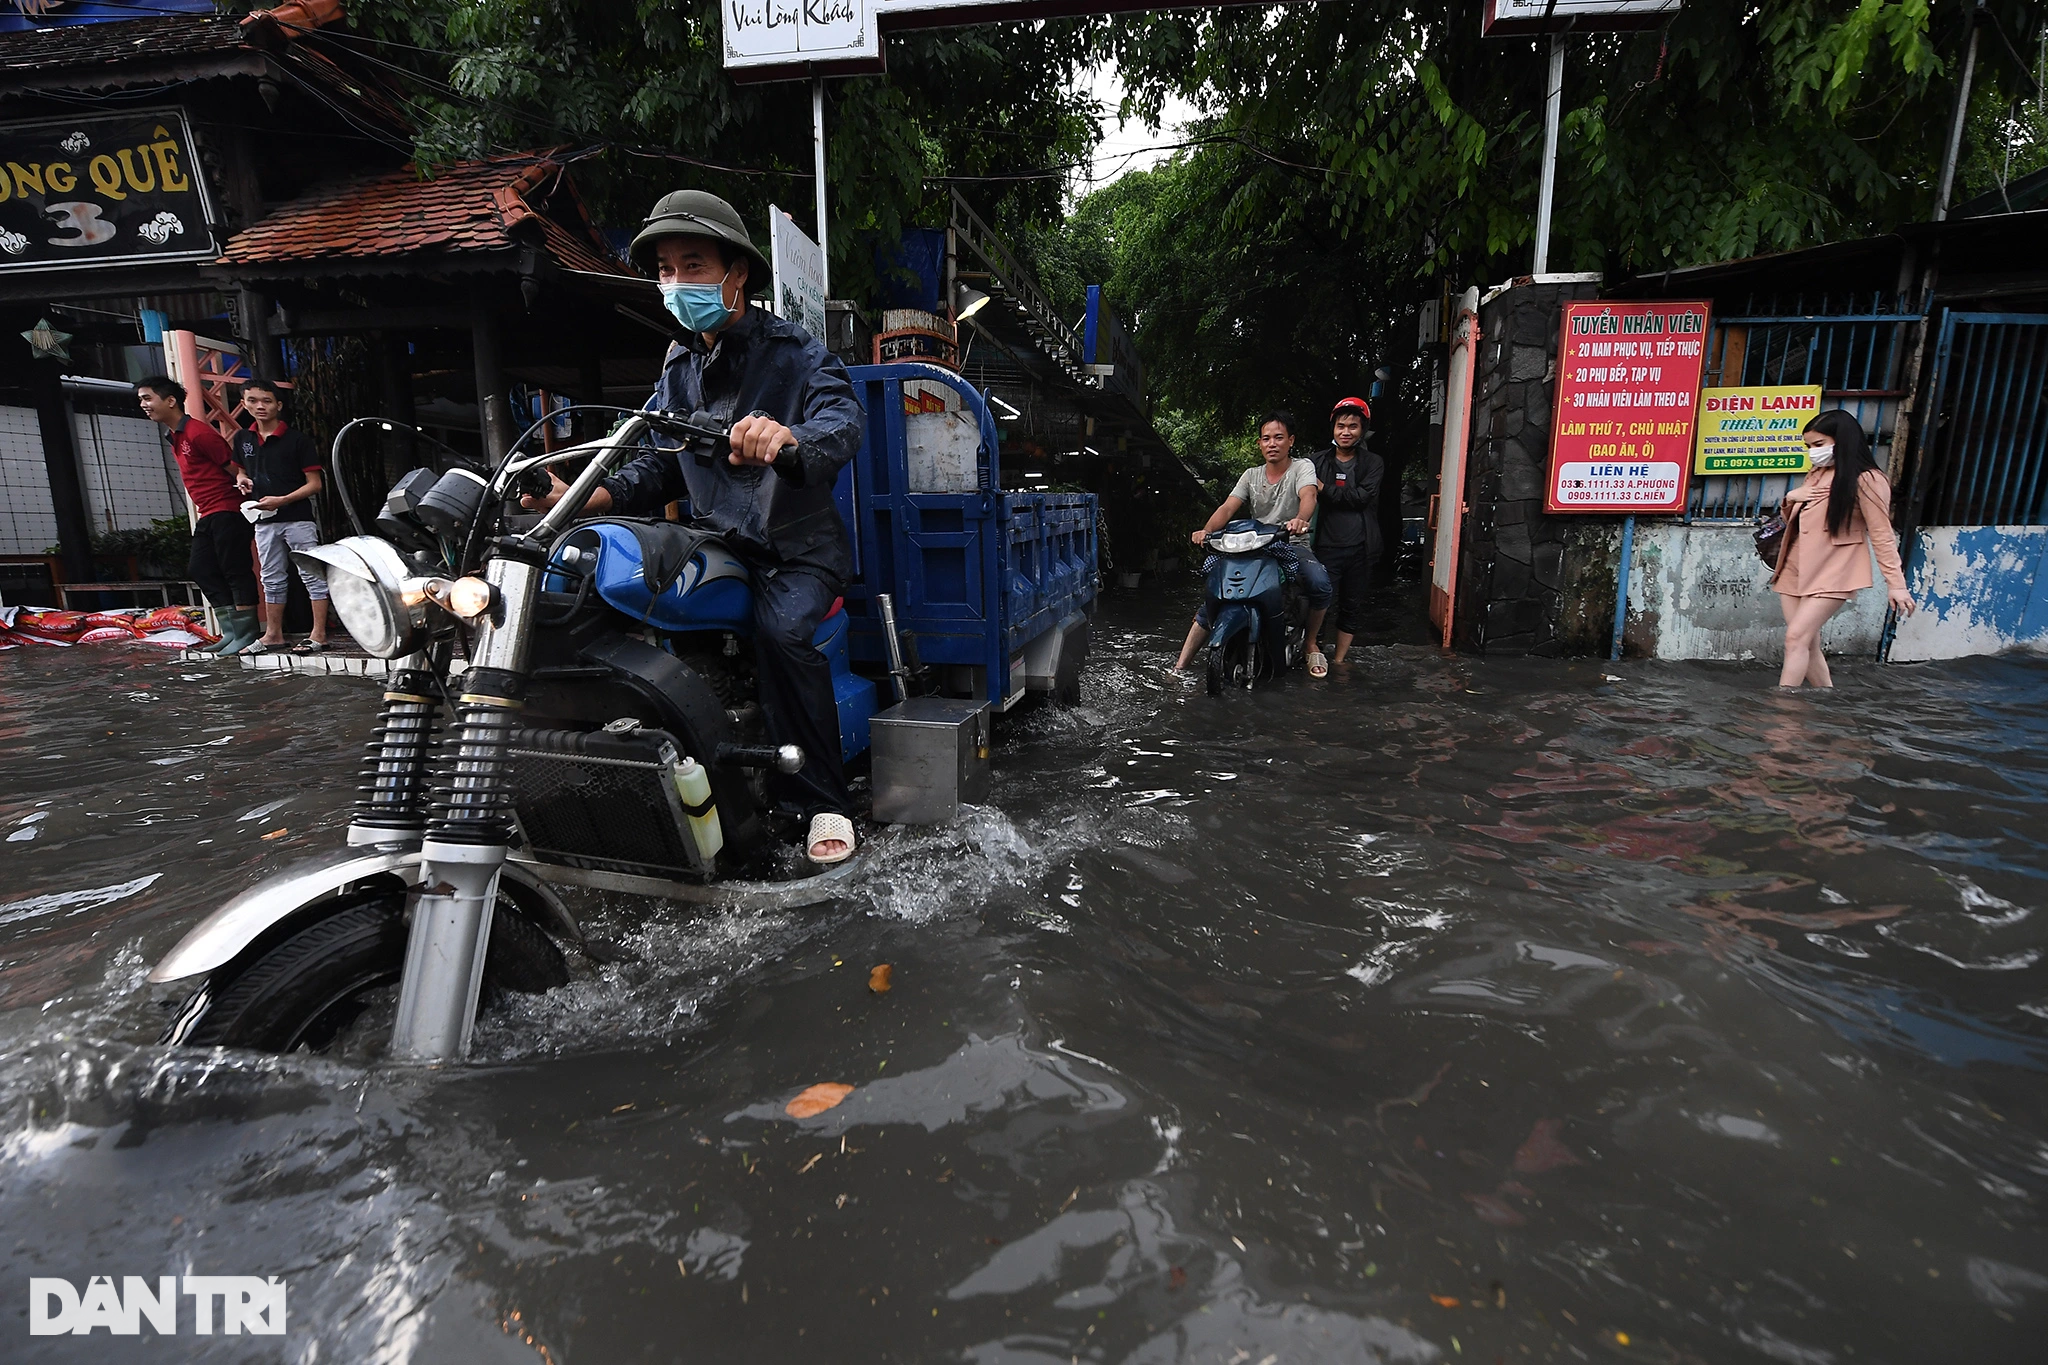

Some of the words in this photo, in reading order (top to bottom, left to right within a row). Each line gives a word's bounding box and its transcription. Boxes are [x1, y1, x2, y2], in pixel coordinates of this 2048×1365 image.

[732, 1, 762, 31] Vui
[89, 125, 189, 200] QUÊ
[45, 201, 117, 247] 3
[1571, 307, 1619, 335] TUYỂN
[1622, 310, 1664, 335] NHÂN
[1668, 309, 1703, 333] VIÊN
[1578, 342, 1591, 357] 20
[1591, 341, 1612, 357] NAM
[1613, 340, 1638, 360] PHỤC
[1639, 341, 1654, 360] VỤ,
[1656, 336, 1675, 357] TIẾP
[1677, 339, 1700, 359] THỰC
[1575, 367, 1588, 383] 20
[1589, 367, 1608, 385] PHỤ
[1609, 362, 1629, 384] BẾP,
[1631, 366, 1648, 385] TẠP
[1649, 366, 1661, 385] VỤ
[1573, 393, 1585, 407] 30
[1586, 389, 1611, 407] NHÂN
[1612, 389, 1632, 407] VIÊN
[1633, 389, 1653, 407] LÀM
[1654, 392, 1677, 407] THEO
[1678, 391, 1690, 407] CA
[1706, 394, 1754, 415] ĐIỆN
[1761, 396, 1816, 413] LẠNH
[1560, 420, 1586, 436] LÀM
[1589, 420, 1613, 436] THỨ
[1615, 423, 1626, 438] 7,
[1629, 419, 1655, 436] CHỦ
[1657, 419, 1689, 438] NHẬT
[1719, 416, 1767, 431] THIÊN
[1767, 418, 1799, 430] KIM
[1588, 444, 1617, 459] (BAO
[1619, 441, 1638, 459] ĂN,
[1641, 440, 1655, 459] Ở)
[1590, 464, 1624, 477] LIÊN
[1629, 464, 1650, 479] HỆ
[1729, 459, 1754, 468] 0974
[1757, 458, 1775, 467] 162
[1776, 457, 1796, 467] 215
[1627, 478, 1675, 489] A.PHƯƠNG
[1567, 491, 1632, 501] 0909.1111.33
